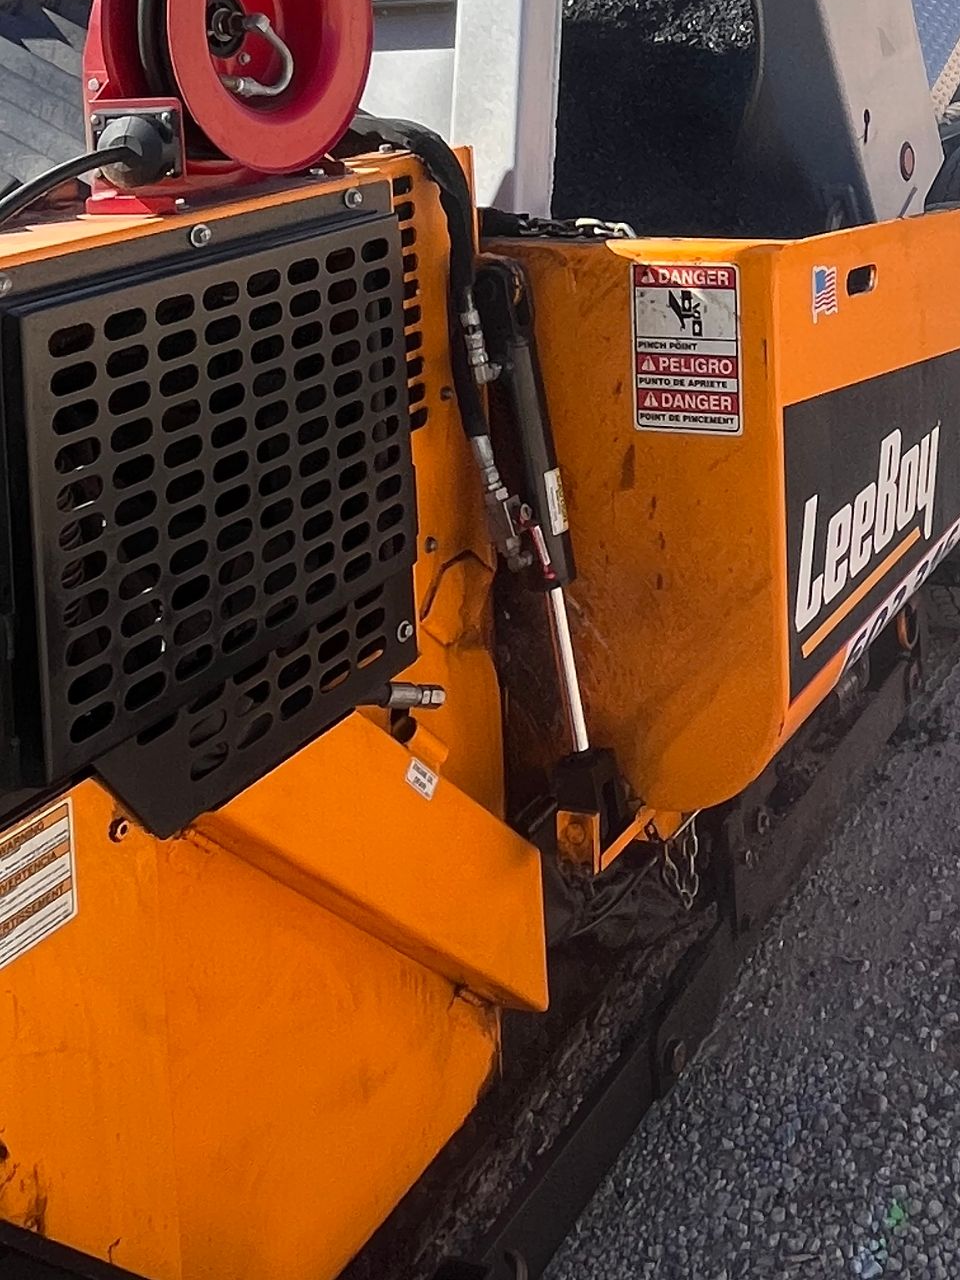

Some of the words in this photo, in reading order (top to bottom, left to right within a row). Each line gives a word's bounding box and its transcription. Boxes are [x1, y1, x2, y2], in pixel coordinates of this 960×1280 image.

[658, 268, 729, 286] DANGER
[638, 341, 667, 350] PINCH
[669, 342, 698, 351] POINT
[659, 357, 733, 375] PELIGRO
[639, 377, 671, 386] PUNTO
[673, 378, 685, 387] DE
[688, 379, 728, 389] APRIETE
[661, 393, 732, 411] DANGER
[639, 412, 667, 421] POINT
[669, 414, 682, 422] DE
[683, 415, 735, 425] PINCEMENT
[795, 426, 940, 633] LeeBoy
